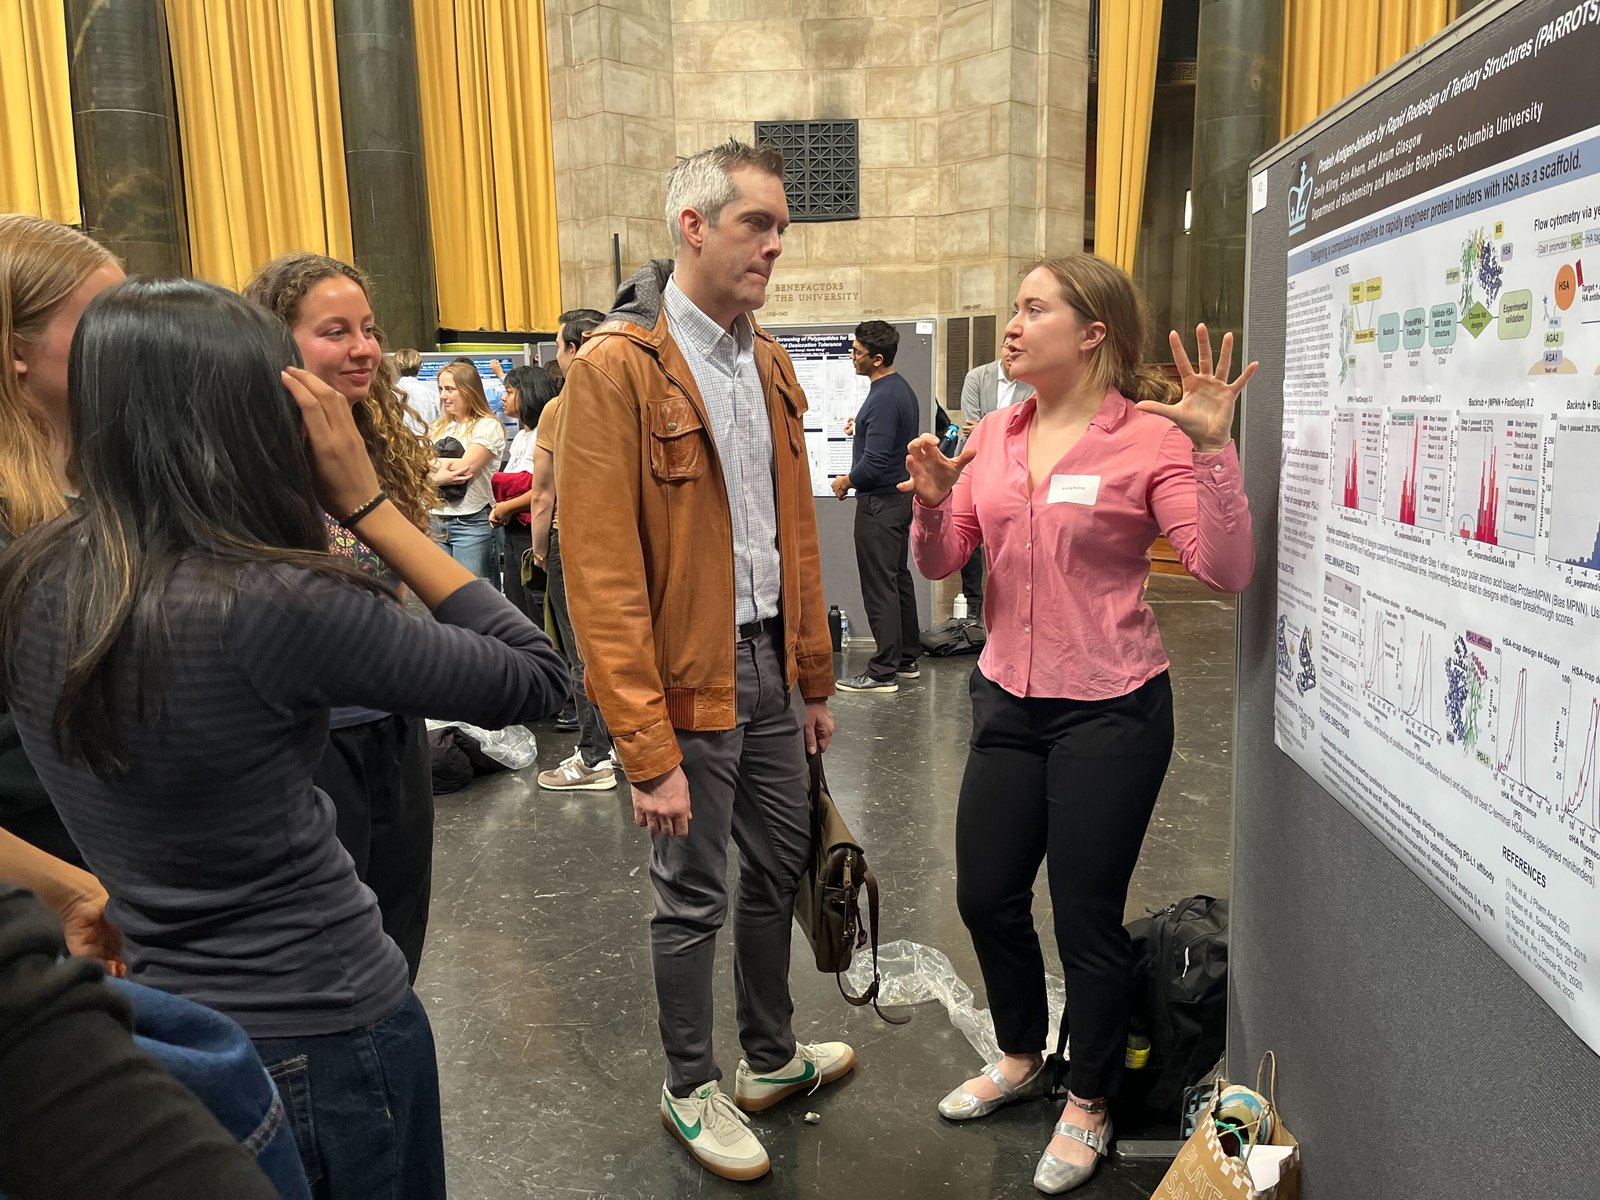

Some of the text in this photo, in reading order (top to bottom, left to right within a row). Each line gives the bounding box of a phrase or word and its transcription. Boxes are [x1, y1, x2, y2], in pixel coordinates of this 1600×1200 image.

[1317, 152, 1335, 175] Protein
[1377, 122, 1386, 143] by
[1385, 108, 1408, 135] Rapid
[1405, 92, 1440, 123] Redesign
[1440, 80, 1451, 104] of
[1451, 67, 1482, 98] Tertiary
[1483, 38, 1533, 80] Structures
[1311, 101, 1543, 221] Department of Biochemistry and Molecular Biophysics, Columbia University
[1313, 183, 1325, 199] Emily
[1340, 170, 1350, 186] Erin
[1367, 153, 1378, 171] and
[1378, 147, 1394, 166] Anum
[1395, 132, 1422, 156] Glasgow
[1310, 246, 1328, 263] Designing
[1331, 232, 1360, 256] computational
[1360, 226, 1378, 246] pipeline
[1379, 224, 1385, 236] to
[1385, 214, 1404, 236] rapidly
[1404, 206, 1430, 229] engineer
[1430, 197, 1454, 222] protein
[1455, 188, 1482, 210] binders
[1484, 178, 1500, 199] with
[1502, 172, 1519, 194] HSA
[1520, 174, 1530, 187] as
[1532, 169, 1538, 183] a
[1540, 149, 1582, 181] scaffold.
[1534, 218, 1548, 232] Flow
[1550, 209, 1581, 231] cytometry
[1582, 205, 1592, 219] via
[1585, 232, 1594, 244] HA
[1549, 240, 1568, 253] promoter
[775, 282, 844, 292] BENEFACTORS
[1558, 280, 1570, 291] HSA
[1582, 283, 1595, 294] Target
[774, 294, 794, 302] THE
[798, 292, 860, 301] UNIVERSITY
[1582, 293, 1589, 301] HA
[1503, 300, 1529, 314] Experimental
[1505, 314, 1524, 324] validation
[807, 335, 839, 343] Polypeptides
[1468, 397, 1484, 407] Backrub
[1566, 400, 1586, 411] Backrub
[1450, 565, 1460, 577] using
[1468, 570, 1479, 581] polar
[1479, 573, 1492, 585] amino
[1493, 576, 1502, 588] acid
[1503, 579, 1517, 593] biased
[1518, 583, 1551, 603] ProteinMPNN
[1552, 594, 1565, 609] (Bias
[1451, 576, 1468, 591] Backrub
[1468, 581, 1477, 593] lead
[1482, 586, 1499, 601] designs
[1500, 592, 1509, 604] with
[1509, 594, 1522, 608] lower
[1522, 600, 1555, 621] breakthrough
[1555, 612, 1575, 626] scores.
[1502, 637, 1521, 652] HSA-trap
[1522, 644, 1537, 658] design
[1543, 652, 1560, 668] display
[1571, 665, 1595, 684] HSA-trap
[1476, 750, 1489, 764] PD-L1
[1460, 784, 1473, 803] display
[1473, 794, 1479, 804] of
[1479, 796, 1488, 811] best
[1488, 803, 1511, 827] C-terminal
[1511, 819, 1536, 845] HSA-traps
[1536, 837, 1562, 863] (designed
[1562, 855, 1596, 888] minibinders).
[1462, 849, 1476, 868] PD-L1
[1583, 856, 1594, 871] (PE)
[1502, 845, 1547, 889] REFERENCES
[1533, 897, 1547, 916] Pharm
